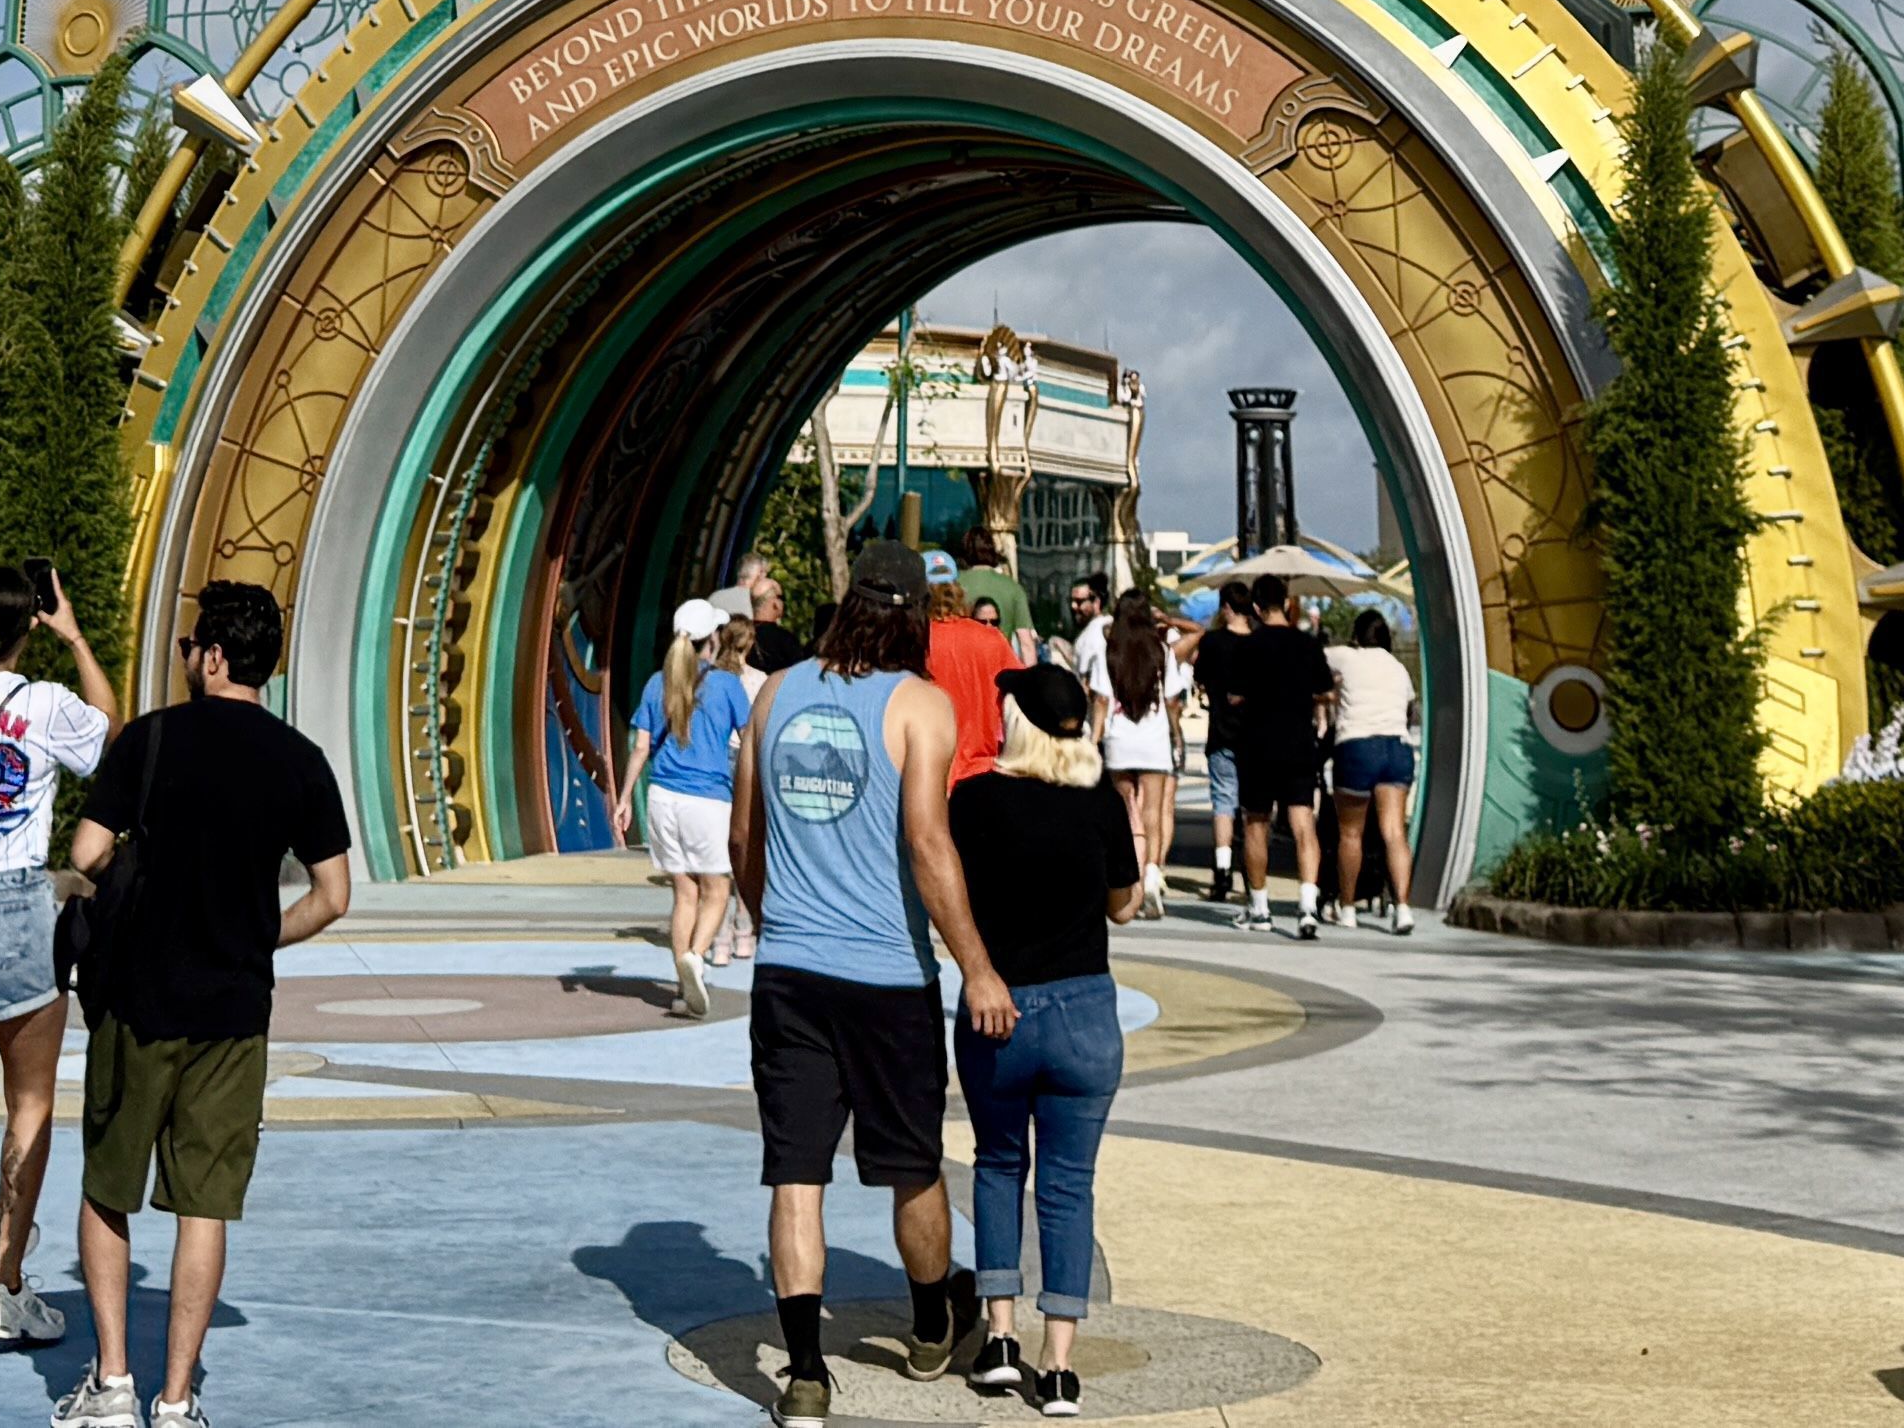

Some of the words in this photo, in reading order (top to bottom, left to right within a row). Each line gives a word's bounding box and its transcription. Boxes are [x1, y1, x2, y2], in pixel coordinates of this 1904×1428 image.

[507, 7, 644, 105] BEYOND
[523, 75, 597, 143] AND
[603, 31, 680, 88] EPIC
[1093, 20, 1240, 117] DREAMS
